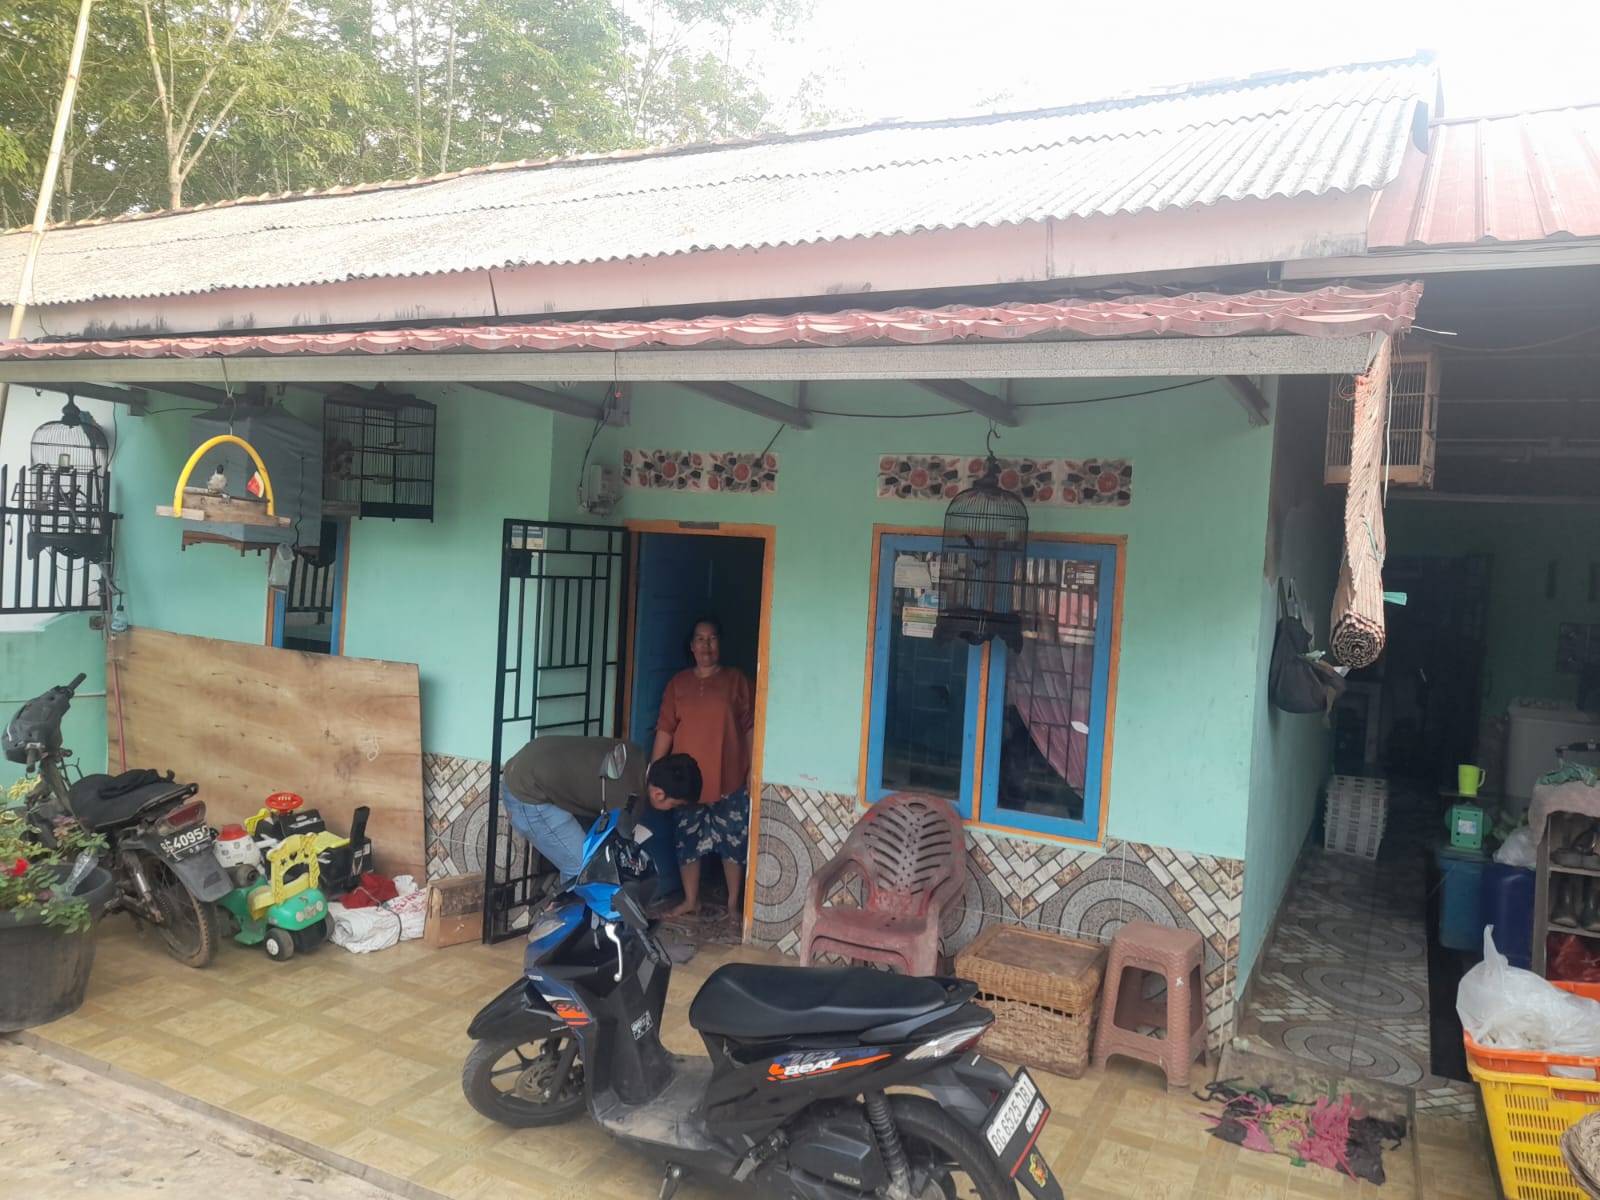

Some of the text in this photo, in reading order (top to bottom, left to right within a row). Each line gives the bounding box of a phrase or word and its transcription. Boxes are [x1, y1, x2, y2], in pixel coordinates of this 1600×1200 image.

[173, 827, 204, 849] 4095
[784, 1057, 841, 1077] BEAT
[1001, 1100, 1022, 1136] 6525
